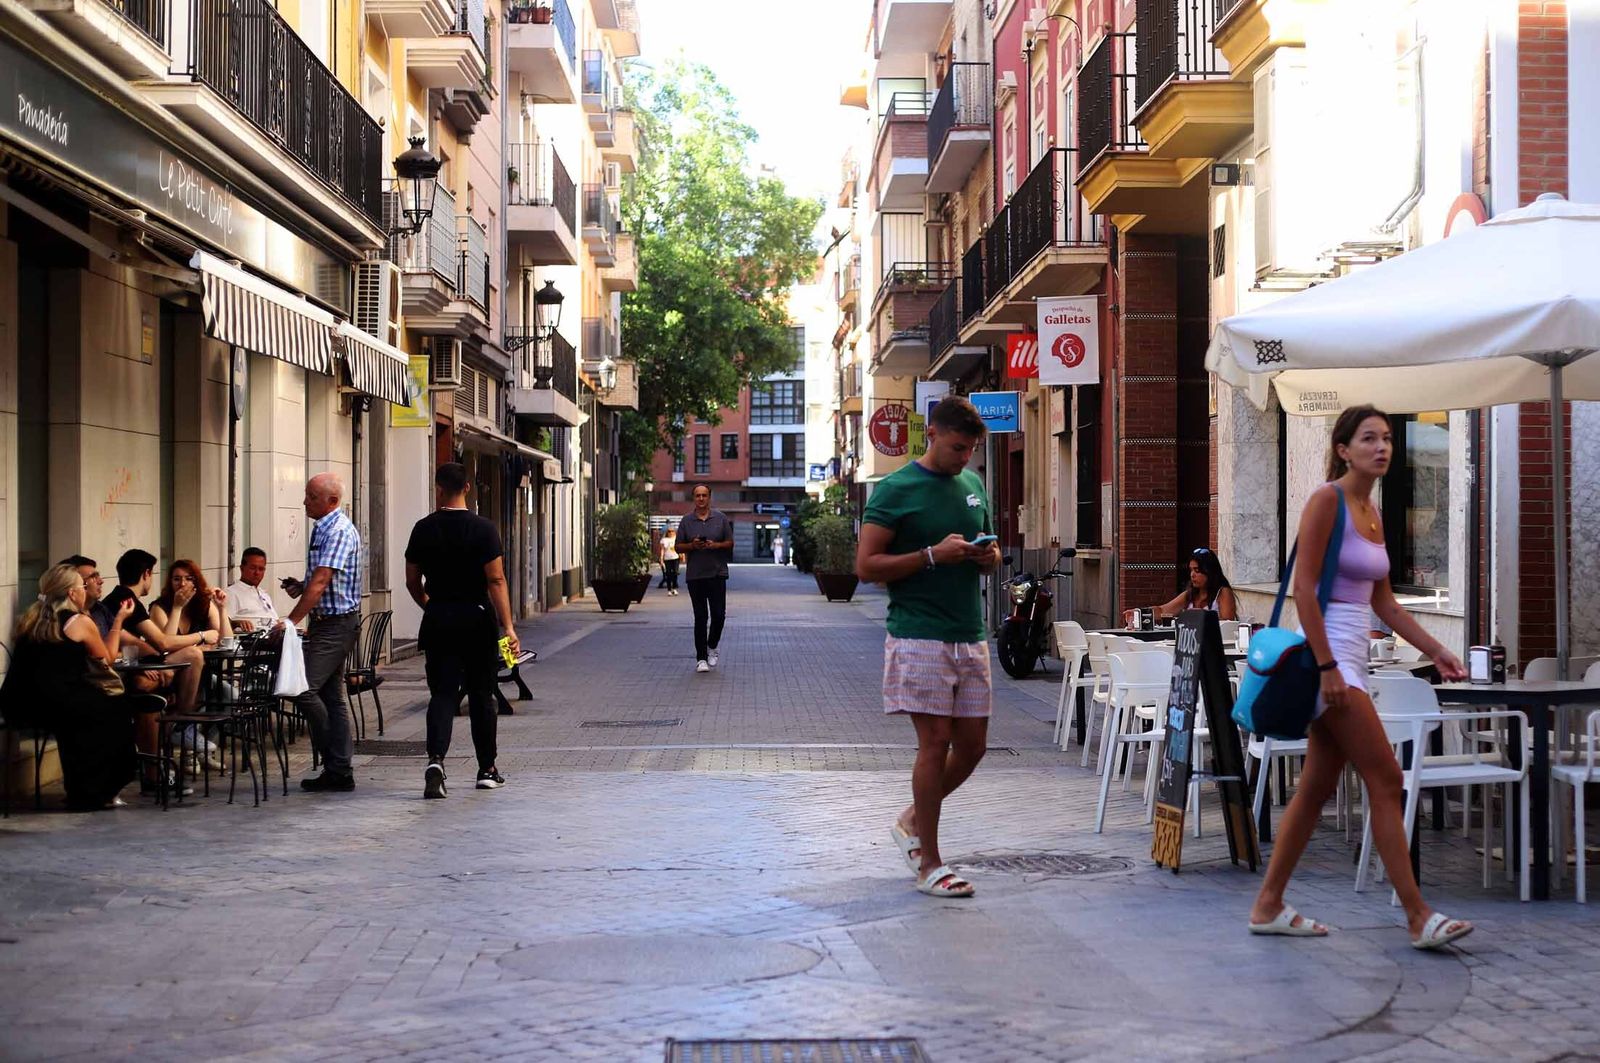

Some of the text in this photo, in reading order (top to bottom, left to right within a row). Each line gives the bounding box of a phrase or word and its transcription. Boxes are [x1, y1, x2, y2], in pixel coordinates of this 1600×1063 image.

[18, 93, 68, 146] Panadería
[159, 151, 233, 247] Le Petit Café
[1044, 314, 1091, 325] Galletas
[883, 405, 907, 420] 1900
